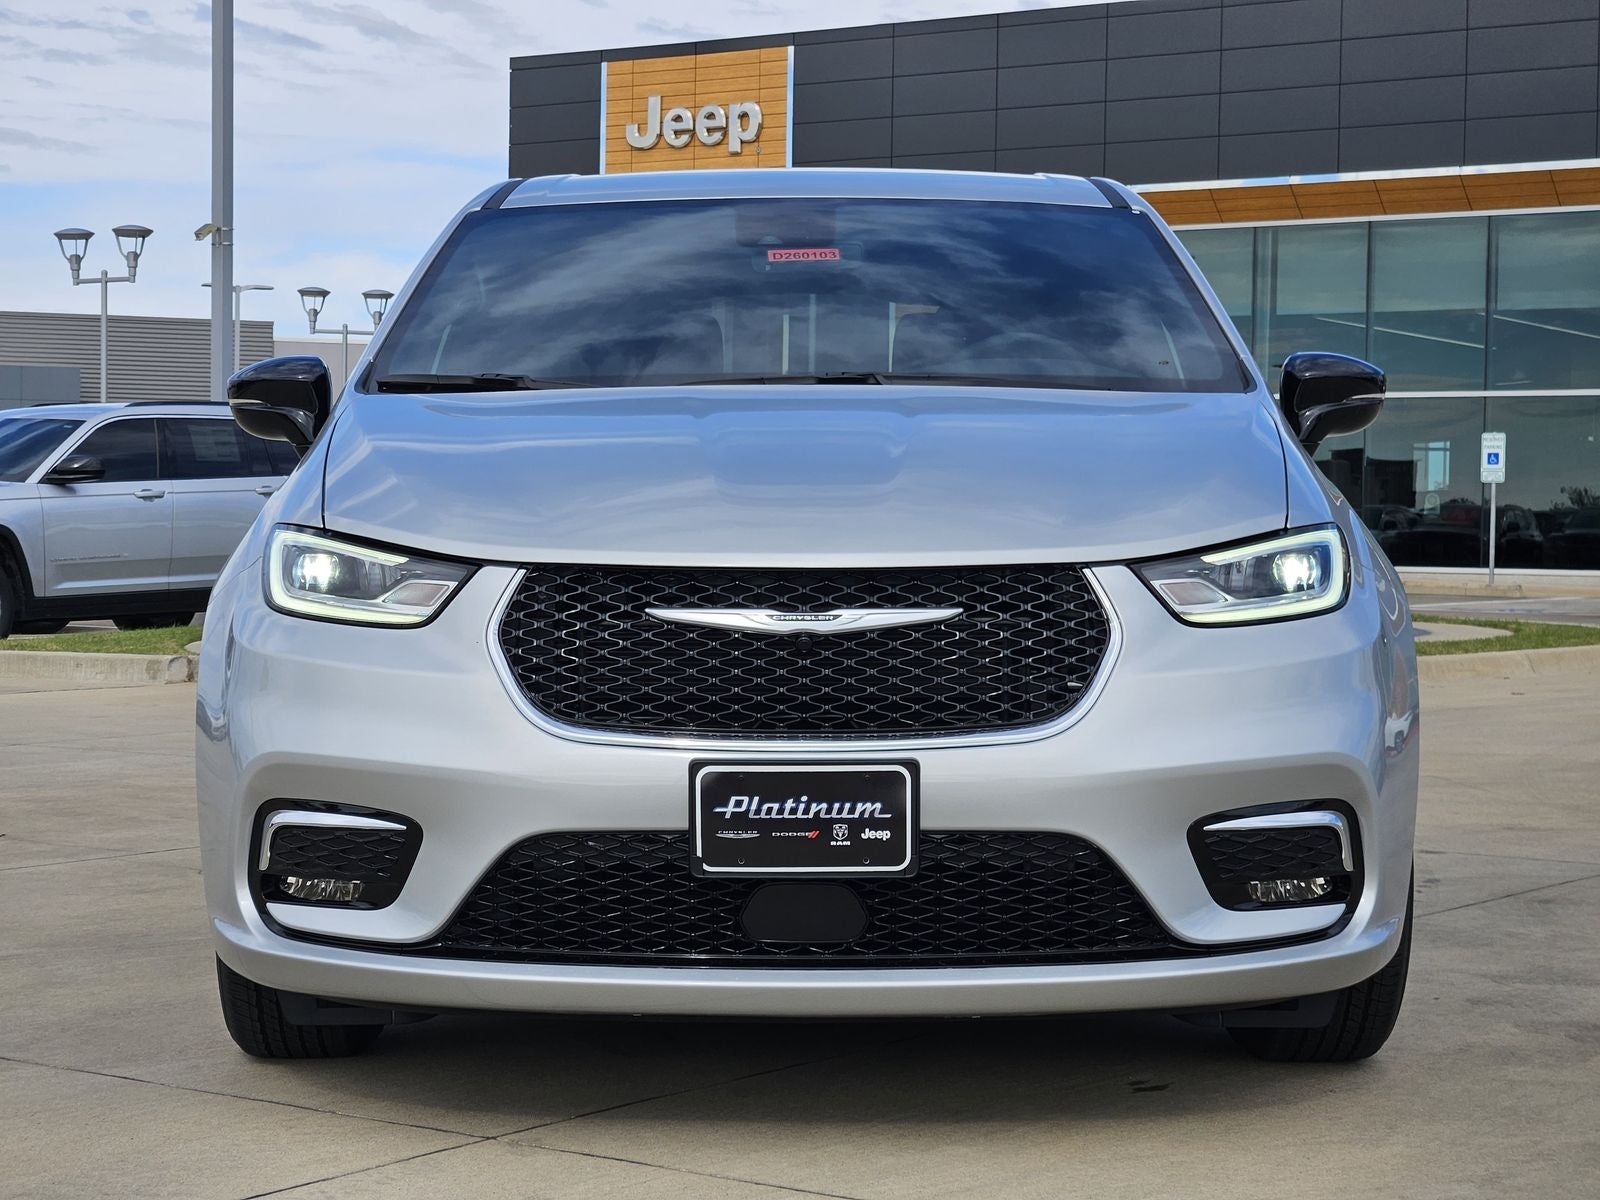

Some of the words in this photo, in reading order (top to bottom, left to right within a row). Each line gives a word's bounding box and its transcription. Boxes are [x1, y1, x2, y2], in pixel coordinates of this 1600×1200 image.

[625, 95, 763, 155] Jeep
[772, 251, 838, 261] D260103
[712, 795, 892, 819] Platinum
[860, 827, 891, 841] Jeep
